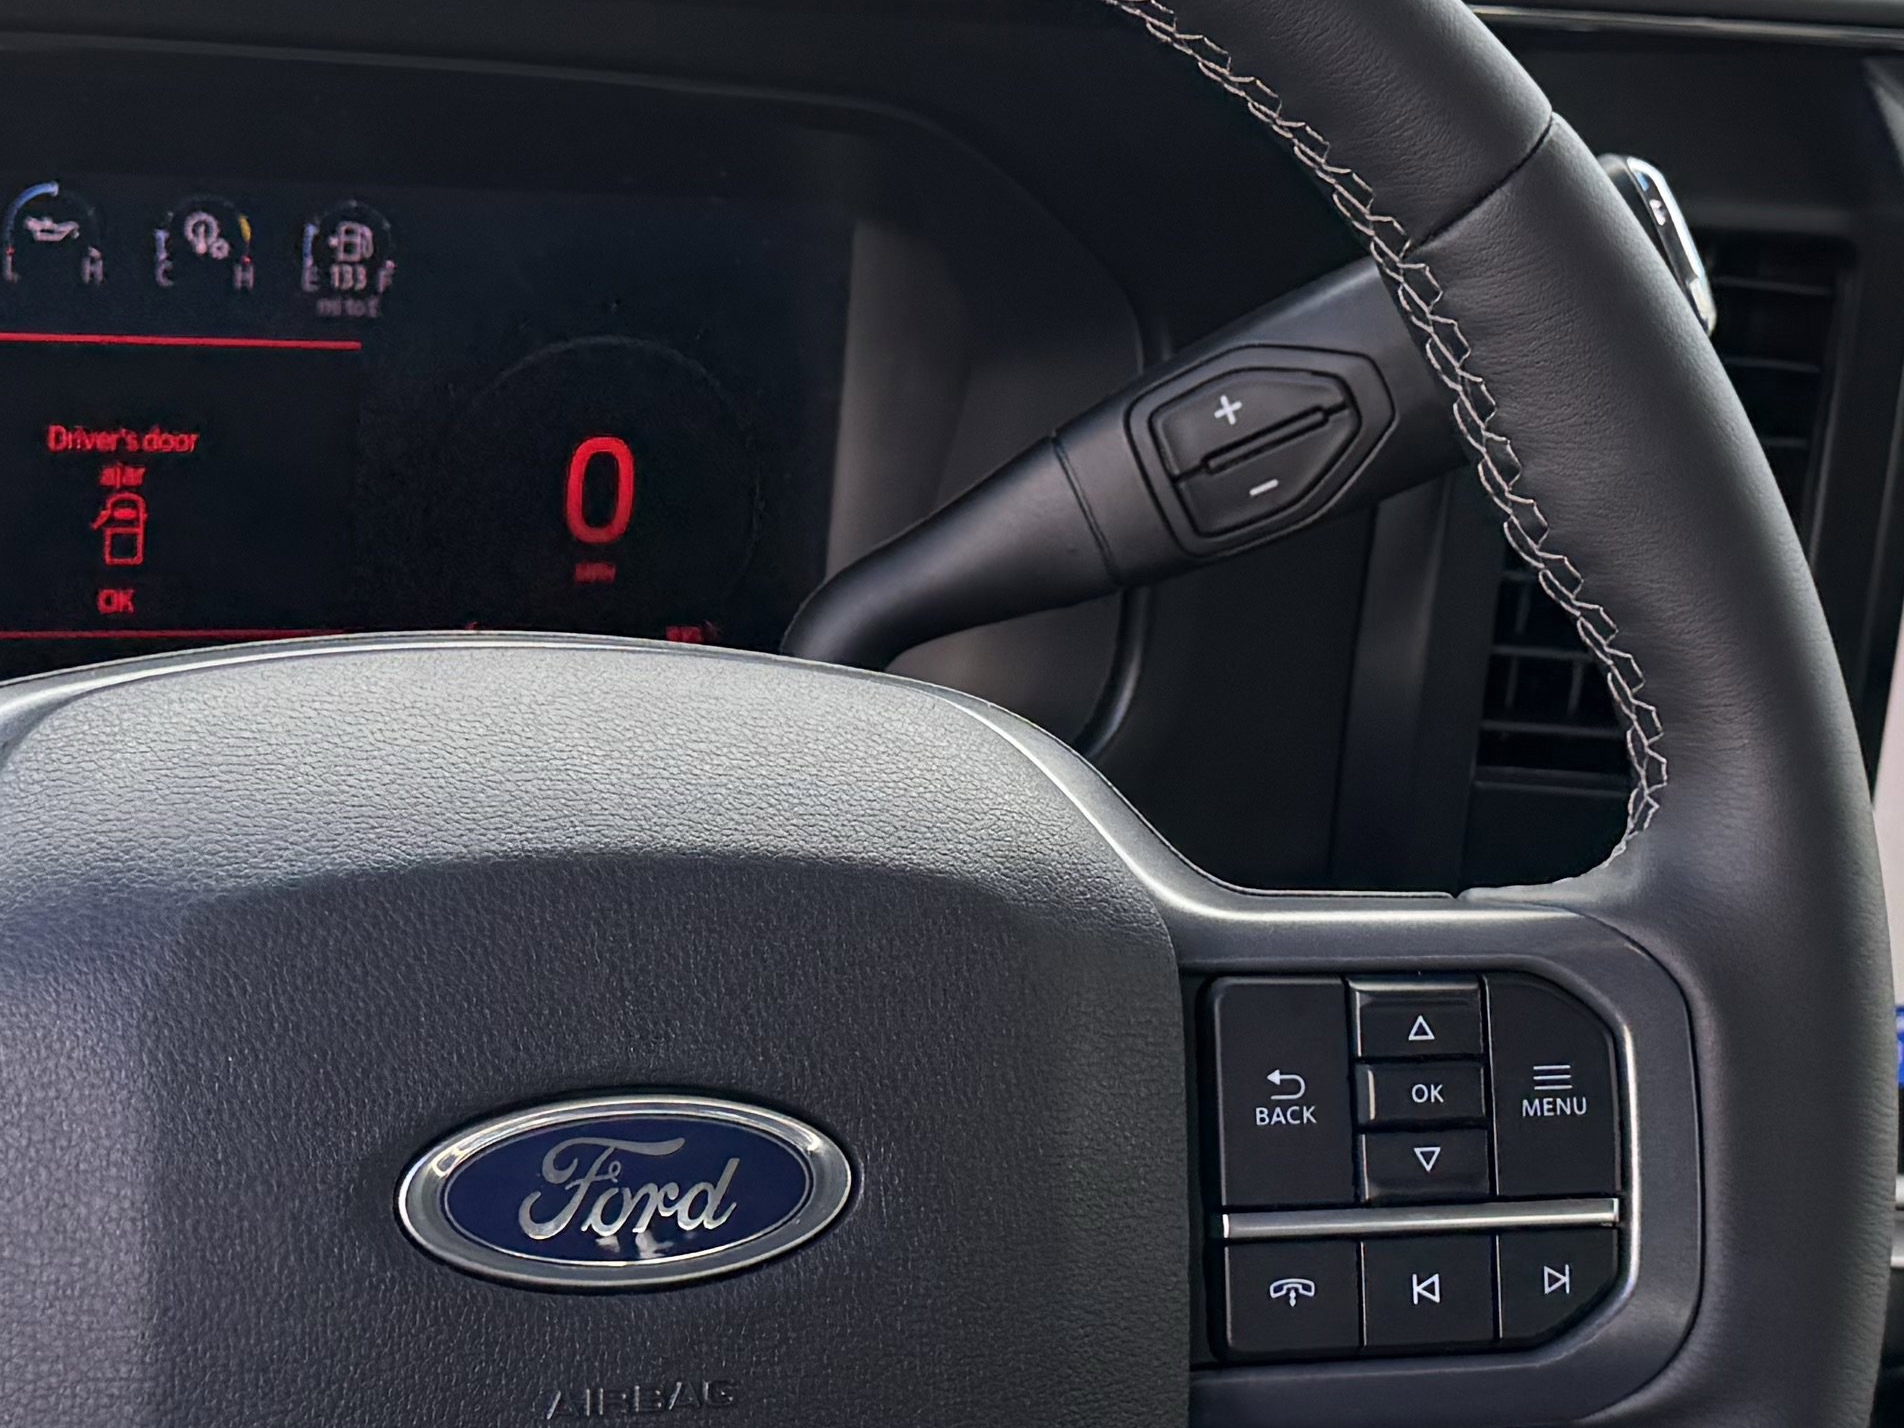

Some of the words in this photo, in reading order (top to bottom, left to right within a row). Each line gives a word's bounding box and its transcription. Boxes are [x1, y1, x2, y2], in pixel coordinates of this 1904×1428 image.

[48, 424, 139, 452] Driver's
[142, 427, 200, 452] door
[563, 435, 634, 545] 0
[97, 587, 135, 614] OK
[1411, 1083, 1445, 1104] OK
[1521, 1096, 1588, 1118] MENU
[1254, 1106, 1317, 1127] BACK
[518, 1136, 741, 1241] Ford
[544, 1378, 736, 1421] AIRBAG
